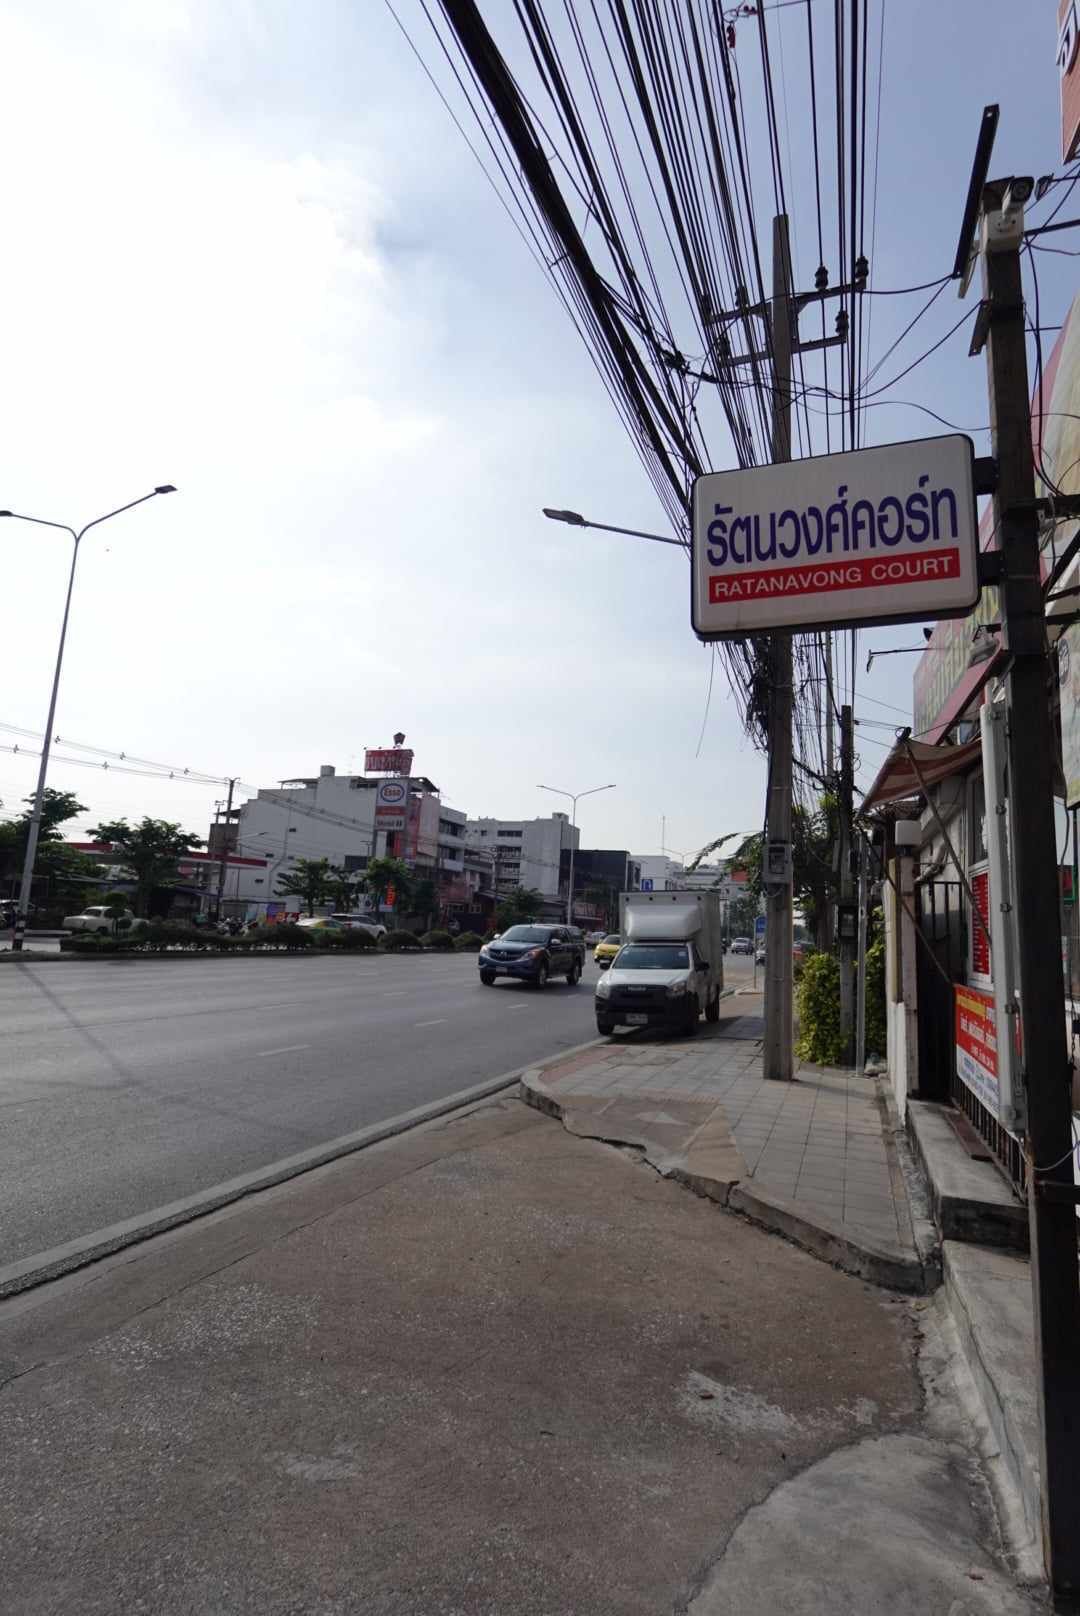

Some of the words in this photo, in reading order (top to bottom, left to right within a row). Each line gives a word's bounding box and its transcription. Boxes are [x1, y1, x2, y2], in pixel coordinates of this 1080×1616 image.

[707, 475, 959, 567] รัตนวงศ์คอร์ท
[714, 566, 862, 598] RATANAVONG
[871, 556, 953, 580] COURT
